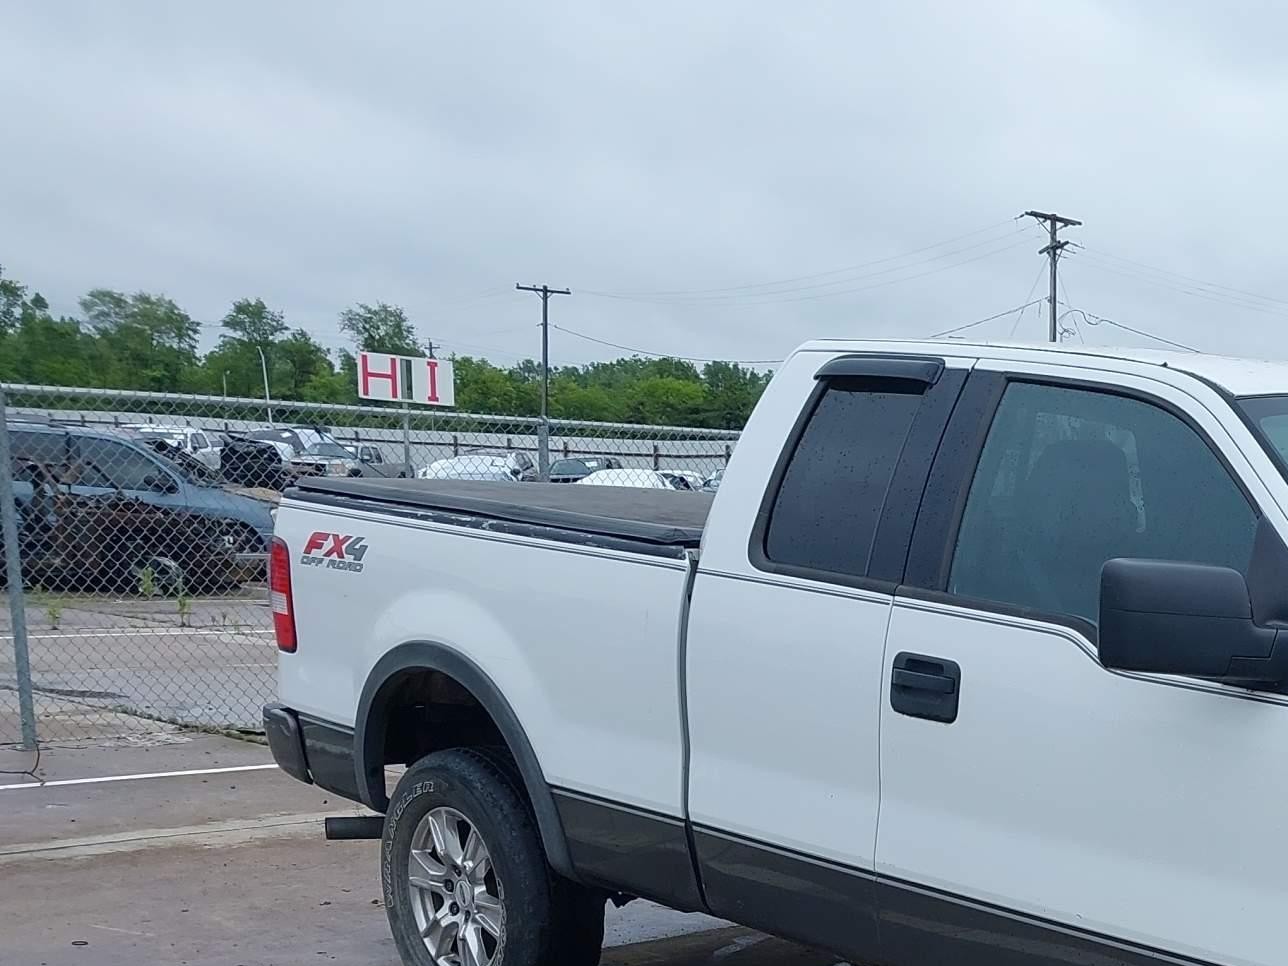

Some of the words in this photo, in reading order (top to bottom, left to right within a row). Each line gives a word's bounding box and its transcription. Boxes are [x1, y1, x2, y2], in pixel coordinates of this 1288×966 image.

[303, 531, 369, 562] FX4
[300, 555, 325, 567] OFF
[326, 558, 364, 573] ROAD
